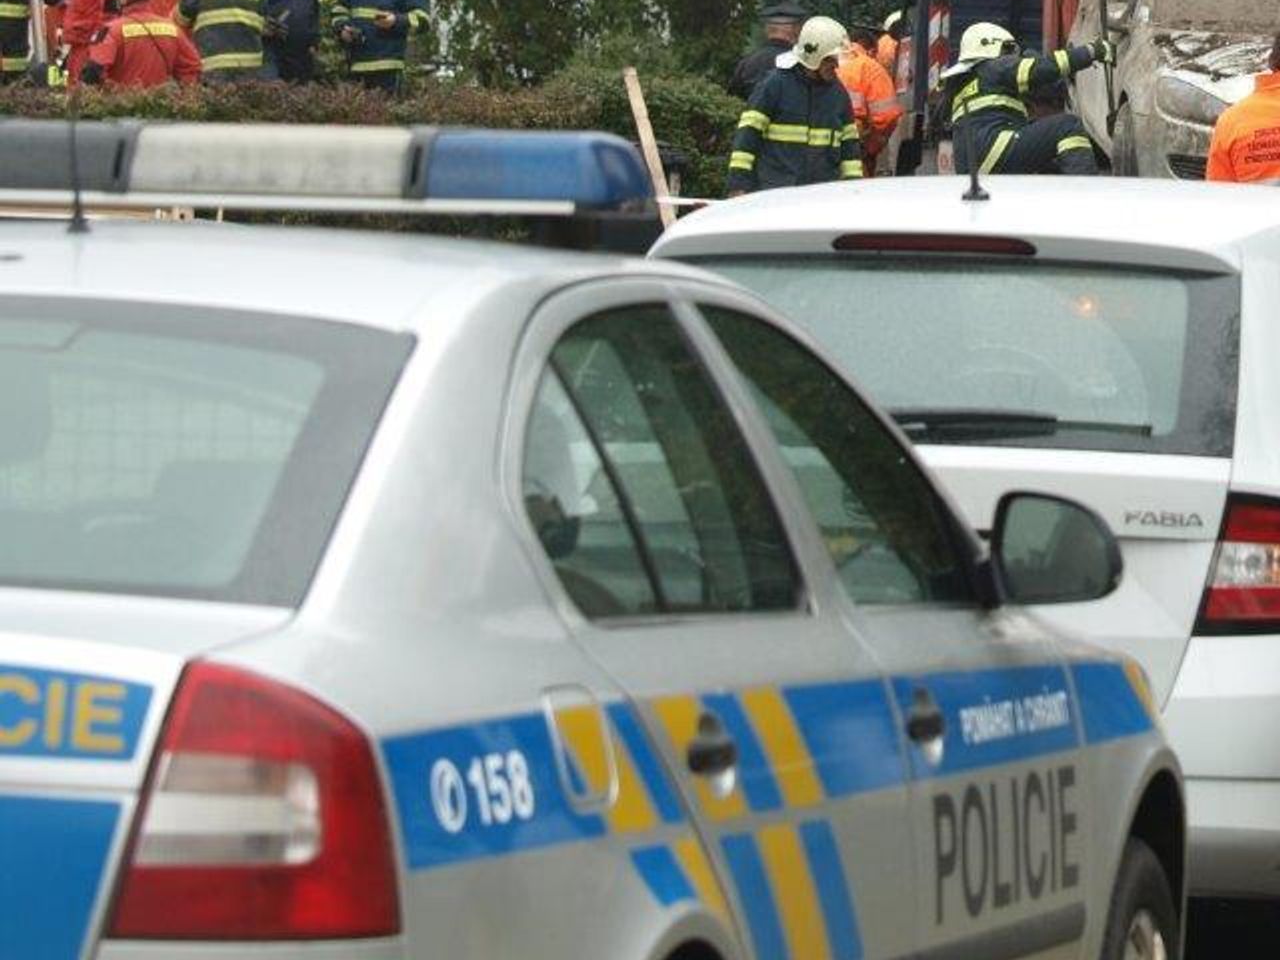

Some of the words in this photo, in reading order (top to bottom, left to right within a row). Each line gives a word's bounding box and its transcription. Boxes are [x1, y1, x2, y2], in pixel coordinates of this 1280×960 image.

[1124, 511, 1204, 528] FABIA
[467, 749, 535, 825] 158
[932, 764, 1080, 926] POLICIE
